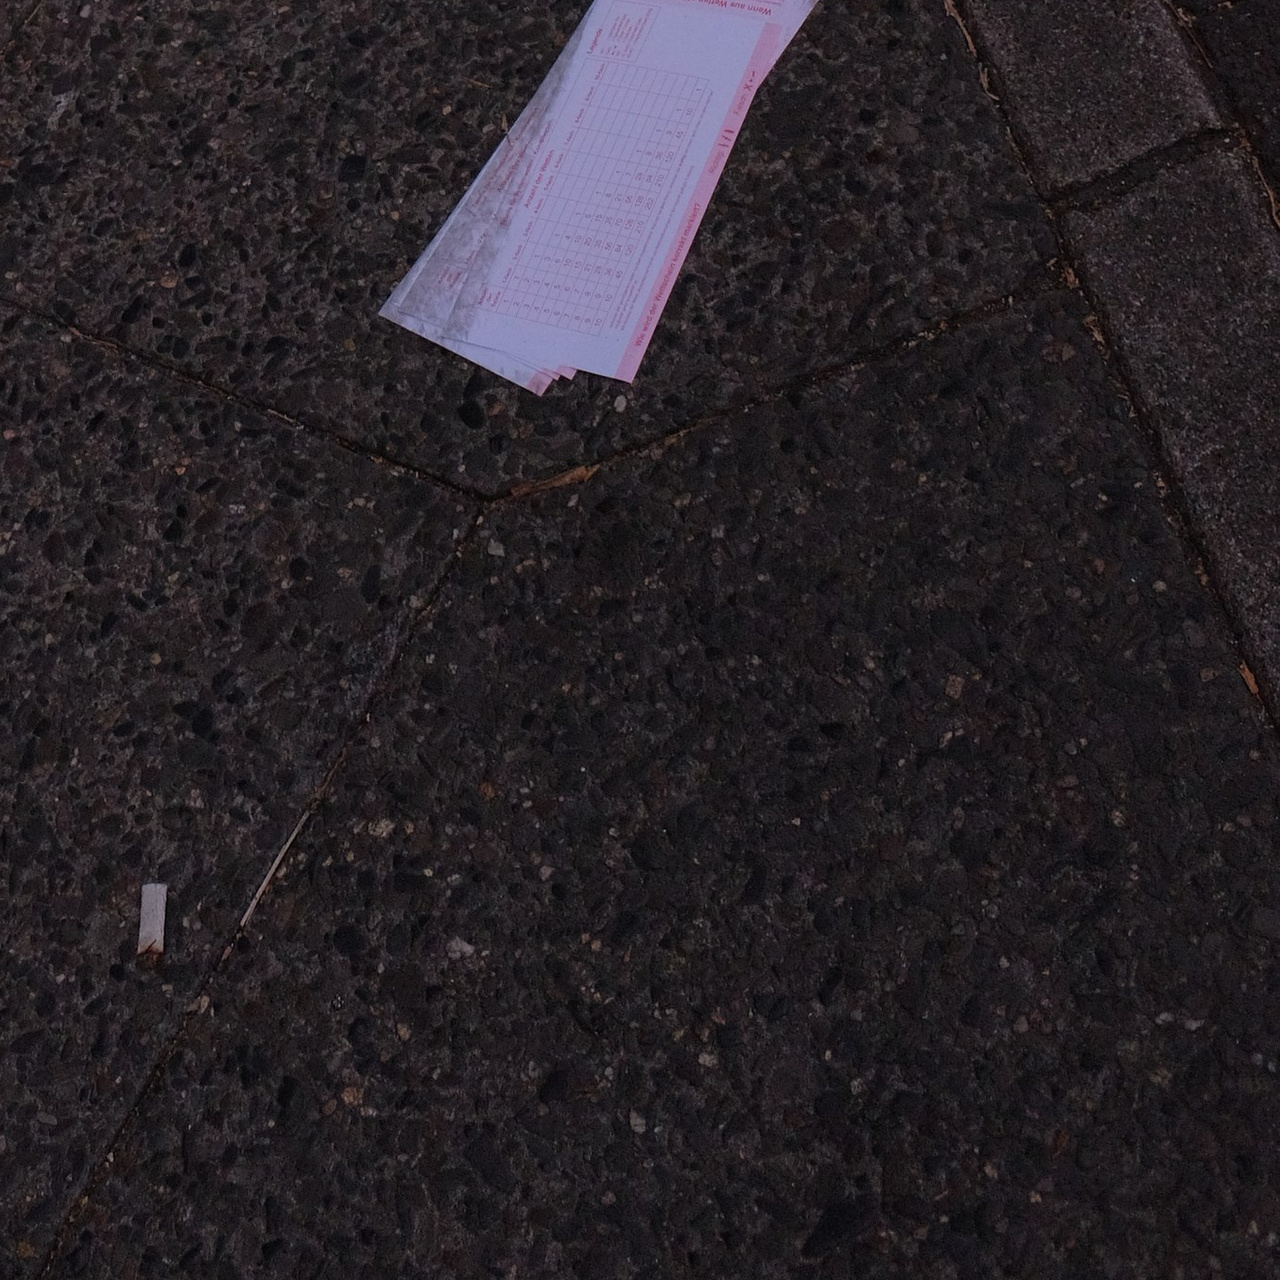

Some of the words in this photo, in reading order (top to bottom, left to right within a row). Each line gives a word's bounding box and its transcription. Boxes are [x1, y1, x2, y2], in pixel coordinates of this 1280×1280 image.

[728, 1, 745, 9] aus
[745, 4, 772, 15] Wenn
[586, 28, 603, 53] Legende
[522, 185, 538, 207] Anzahl
[533, 172, 544, 184] der
[539, 149, 555, 171] Wetten
[632, 332, 646, 346] Wie
[639, 315, 653, 331] wird
[646, 302, 658, 314] der
[652, 262, 676, 301] Wettschein
[670, 236, 687, 261] korrekt
[680, 202, 702, 236] markiert?
